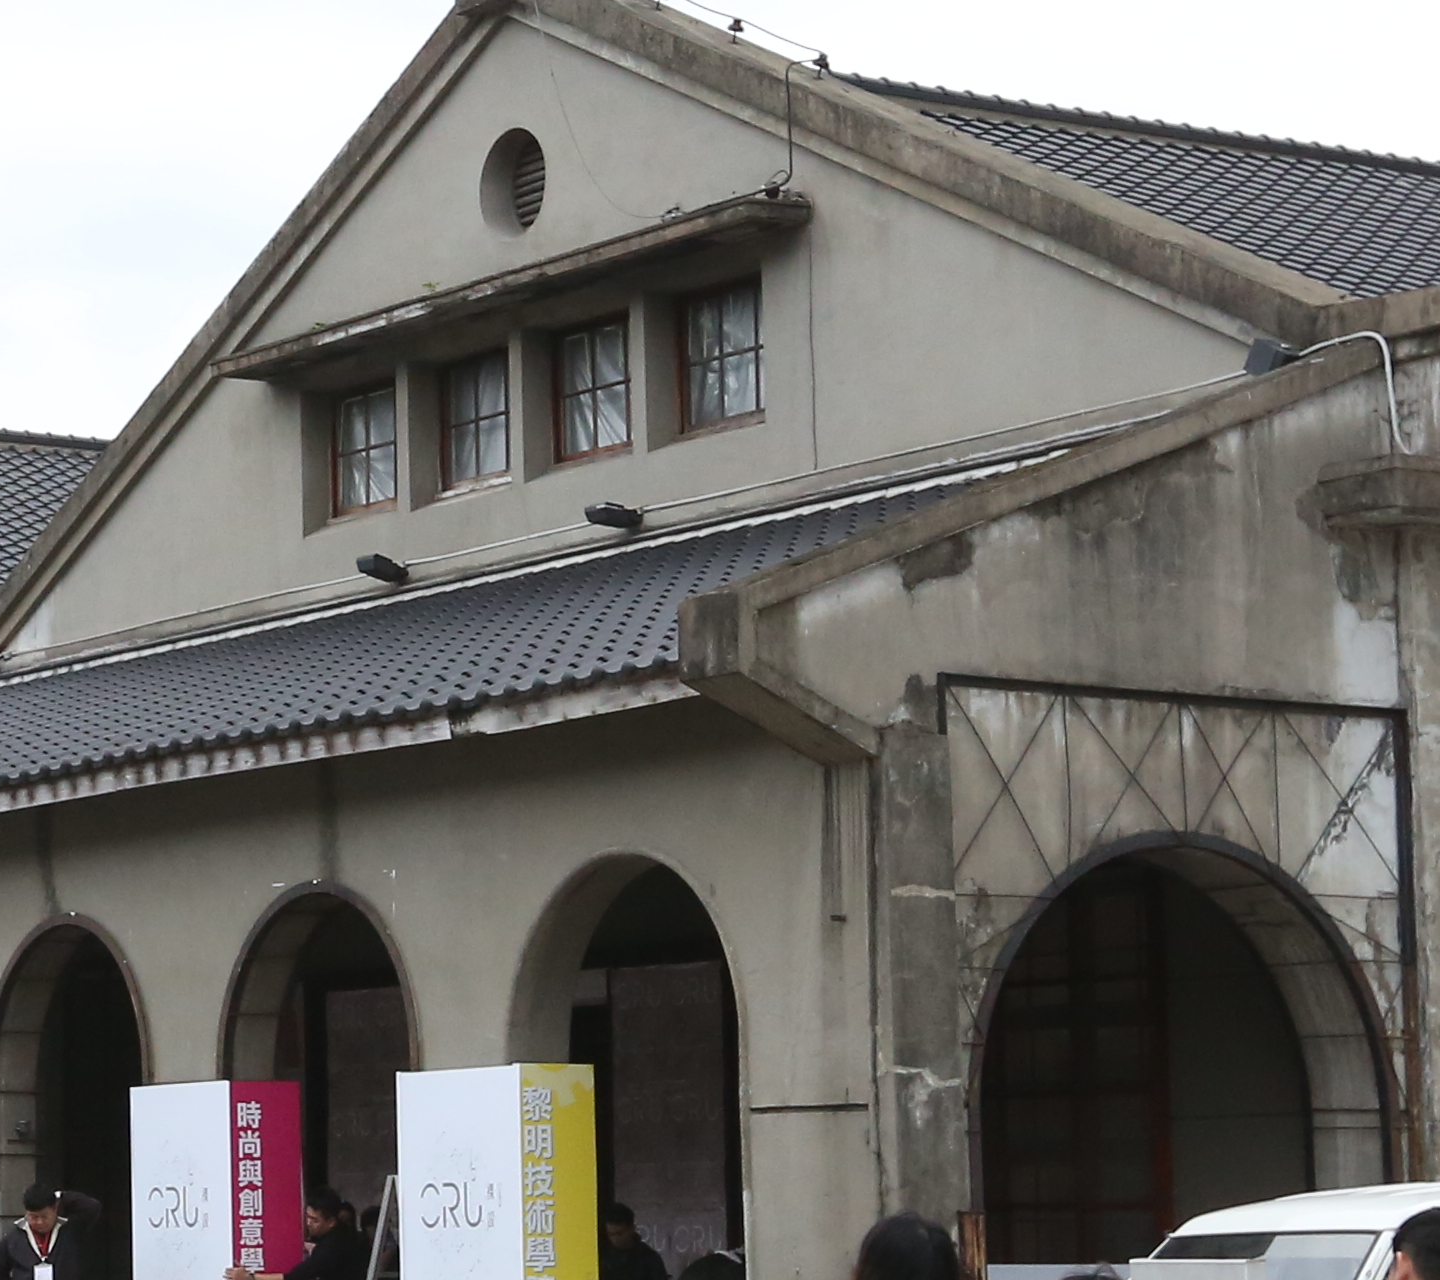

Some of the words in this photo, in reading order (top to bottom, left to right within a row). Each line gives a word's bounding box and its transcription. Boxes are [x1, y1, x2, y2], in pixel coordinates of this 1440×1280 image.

[148, 1186, 199, 1228] CRU
[420, 1182, 483, 1228] CRU
[635, 1224, 668, 1253] RU
